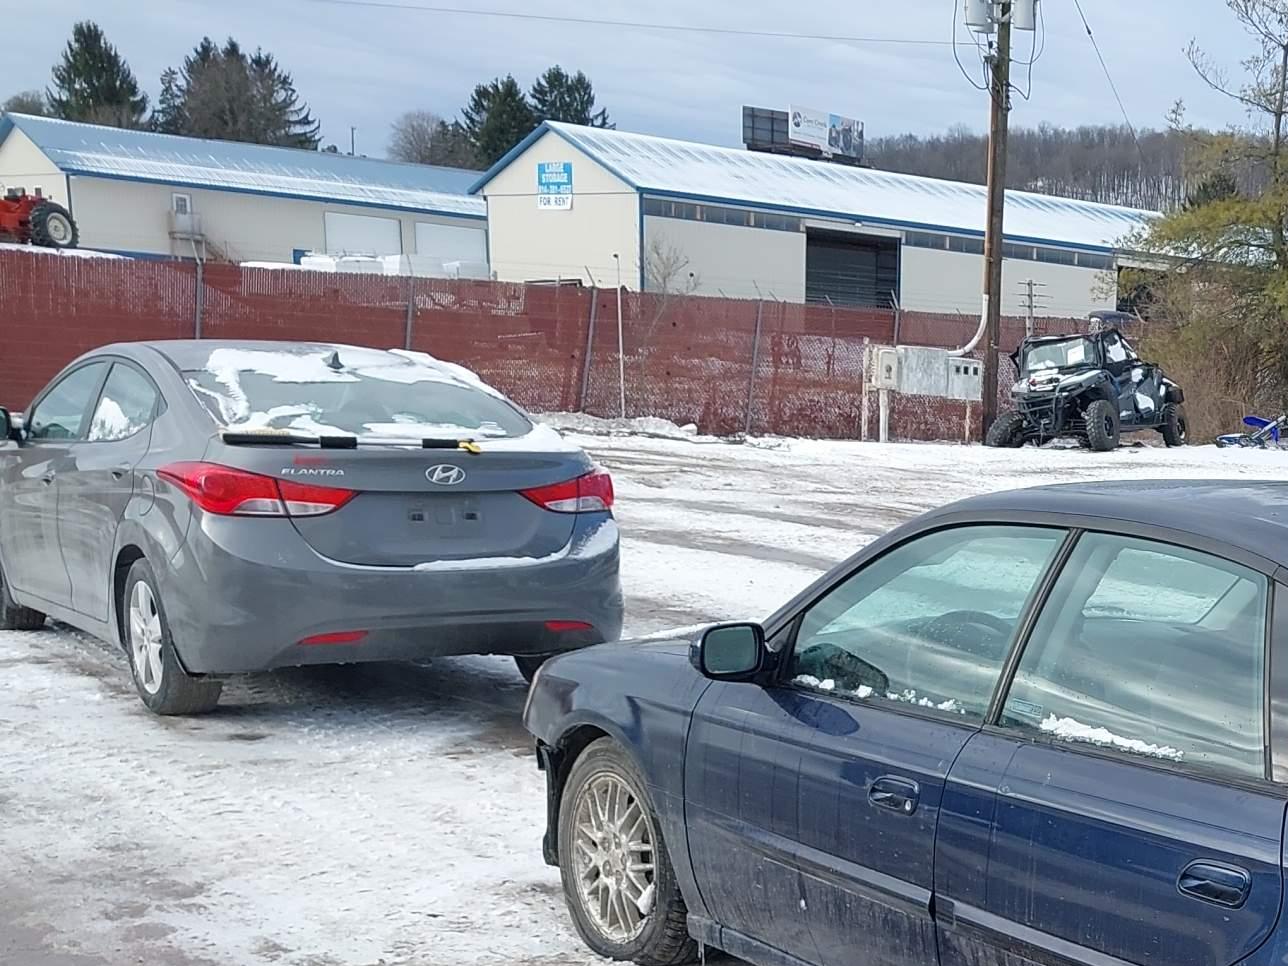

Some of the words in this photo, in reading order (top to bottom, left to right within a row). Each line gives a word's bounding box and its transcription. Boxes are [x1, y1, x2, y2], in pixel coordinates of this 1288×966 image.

[539, 196, 552, 206] FOR
[554, 196, 569, 206] RENT
[281, 467, 345, 477] ELANTRA
